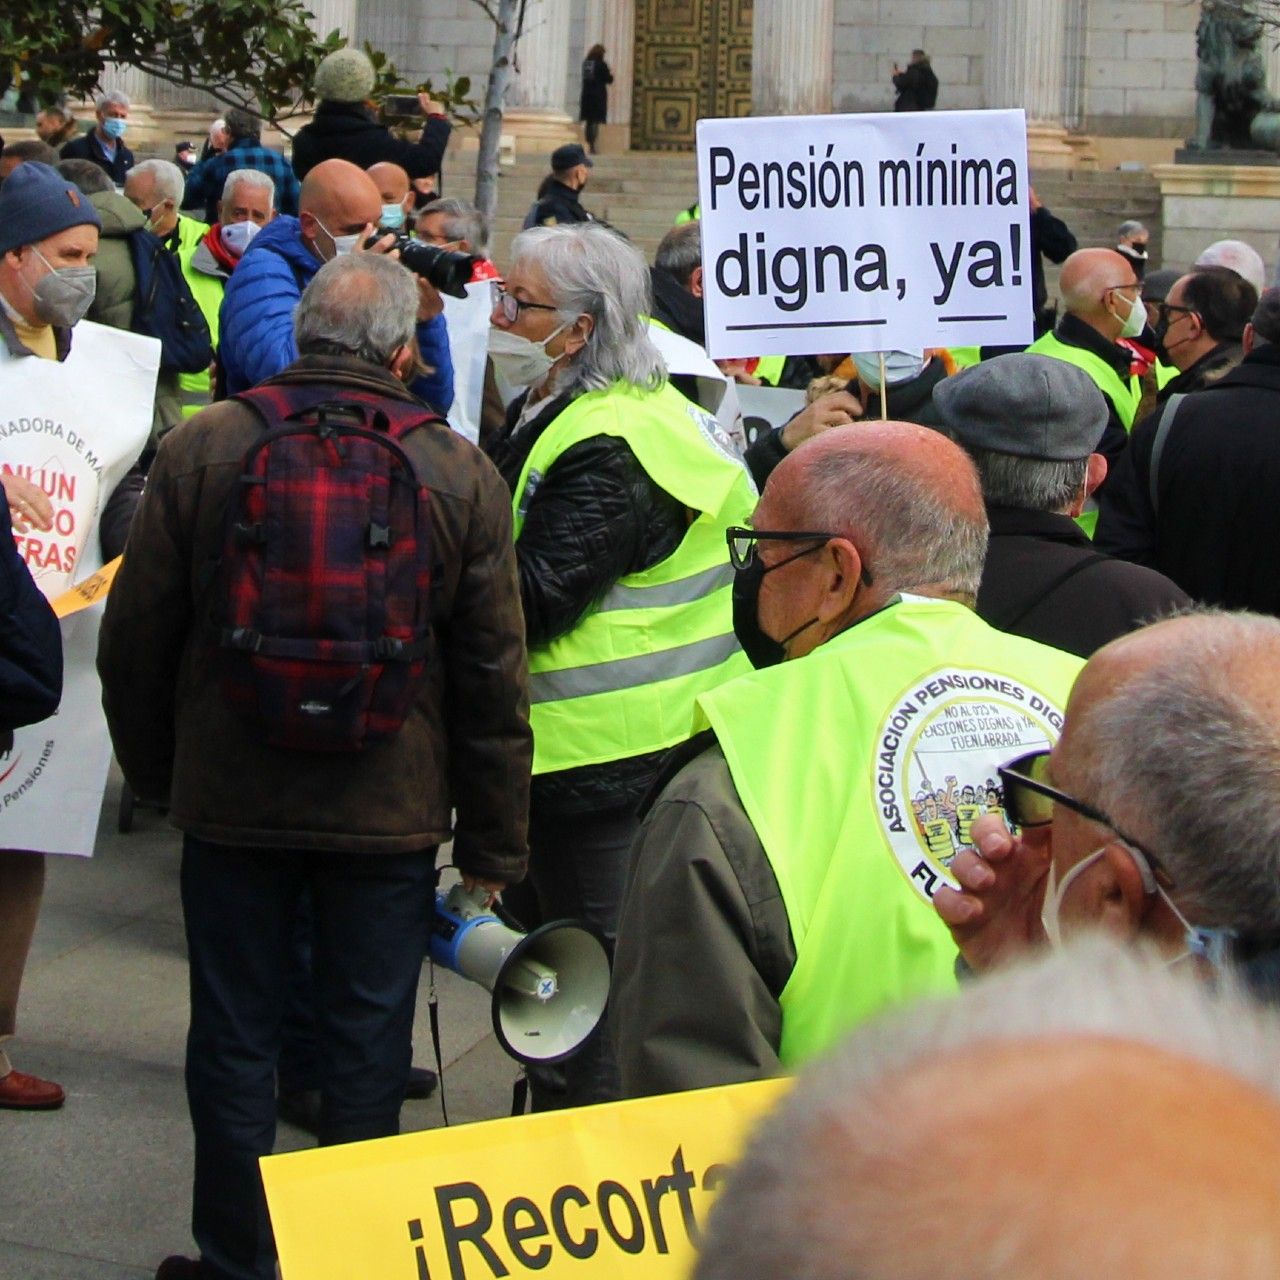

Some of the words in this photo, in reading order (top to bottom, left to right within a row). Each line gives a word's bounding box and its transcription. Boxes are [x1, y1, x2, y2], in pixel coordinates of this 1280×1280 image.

[709, 143, 865, 211] Pensión
[878, 142, 1019, 208] mínima
[715, 231, 907, 312] digna,
[929, 223, 1022, 305] ya!
[66, 431, 85, 454] DE
[39, 469, 77, 502] UN
[12, 534, 78, 574] TRAS
[944, 705, 959, 719] NO
[978, 715, 1015, 731] DIGNAS
[878, 700, 919, 834] ASOCIACIÓN
[914, 674, 1025, 707] PENSIONES
[950, 731, 1022, 751] FUENLABRADA
[3, 739, 55, 808] Pensiones
